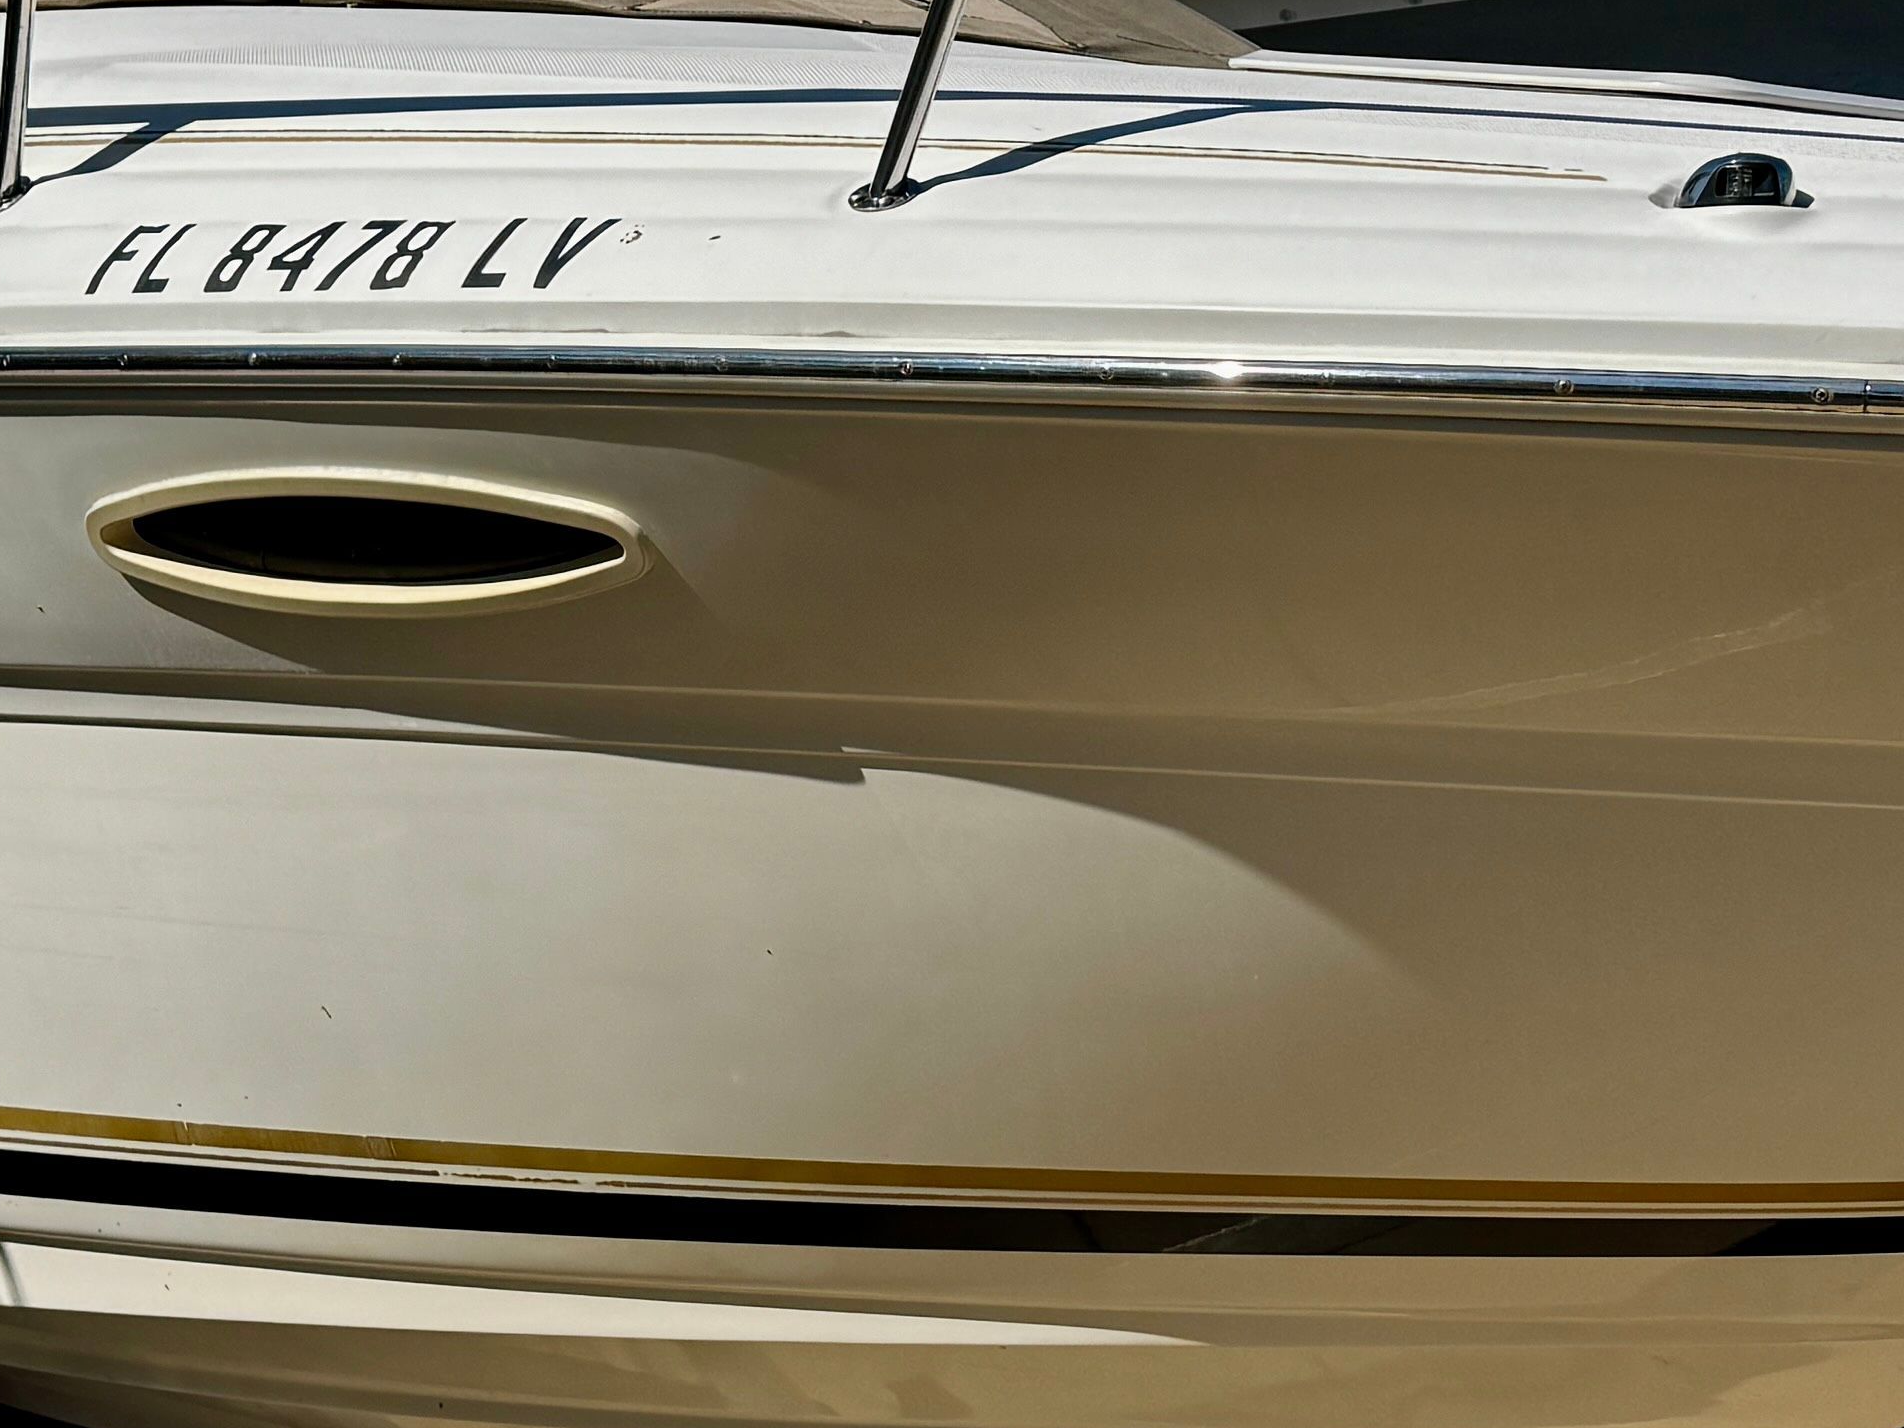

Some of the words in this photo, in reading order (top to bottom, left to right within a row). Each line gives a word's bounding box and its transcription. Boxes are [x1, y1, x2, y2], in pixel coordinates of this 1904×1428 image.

[84, 223, 197, 295] FL
[203, 219, 457, 293] 8478
[461, 217, 622, 290] LV
